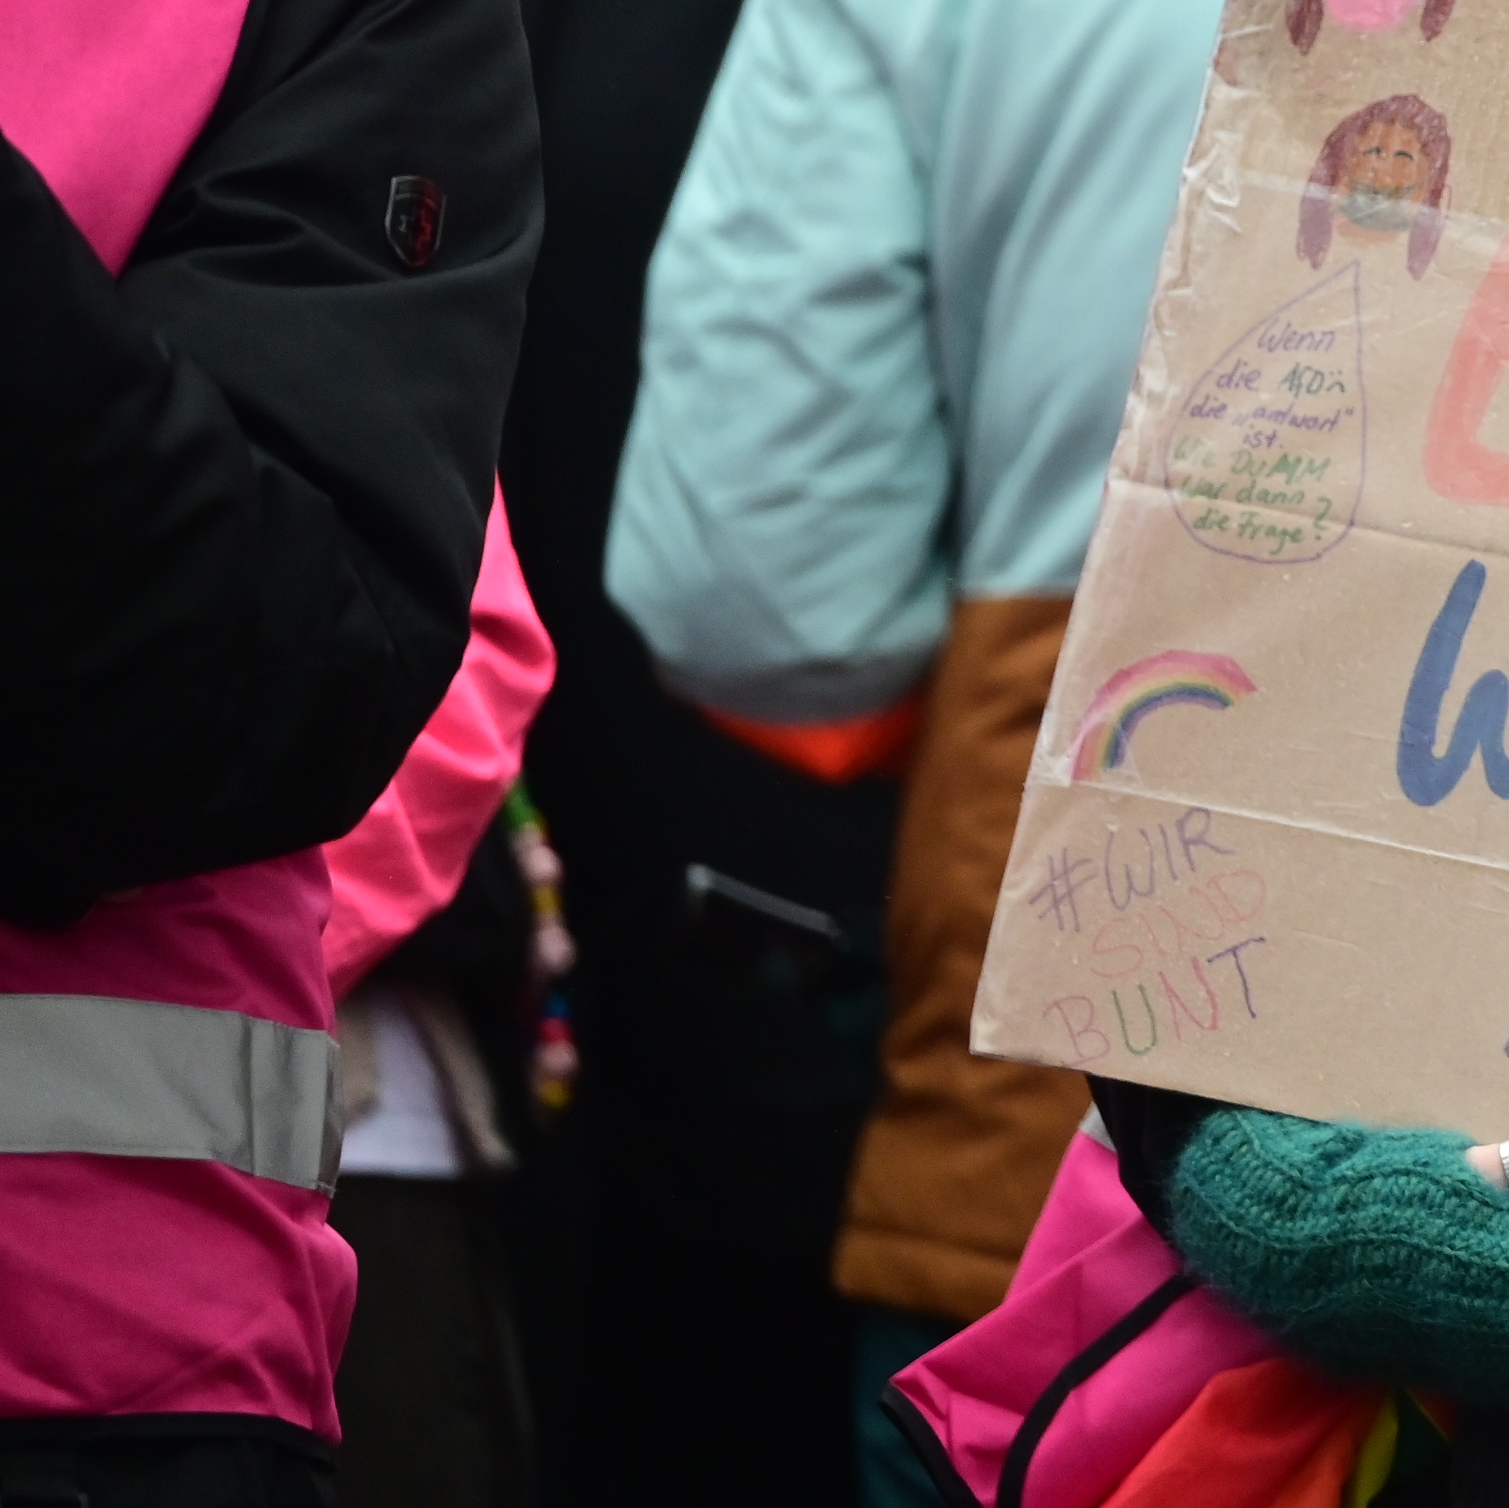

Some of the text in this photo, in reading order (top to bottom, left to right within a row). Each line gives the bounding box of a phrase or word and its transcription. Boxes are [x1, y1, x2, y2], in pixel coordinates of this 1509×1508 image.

[1257, 316, 1336, 353] Wenn
[1214, 358, 1262, 392] die
[1190, 394, 1228, 419] die
[1235, 478, 1306, 504] dann
[1193, 508, 1230, 532] die
[1029, 807, 1236, 932] #WIR
[1042, 936, 1267, 1069] BUNT
